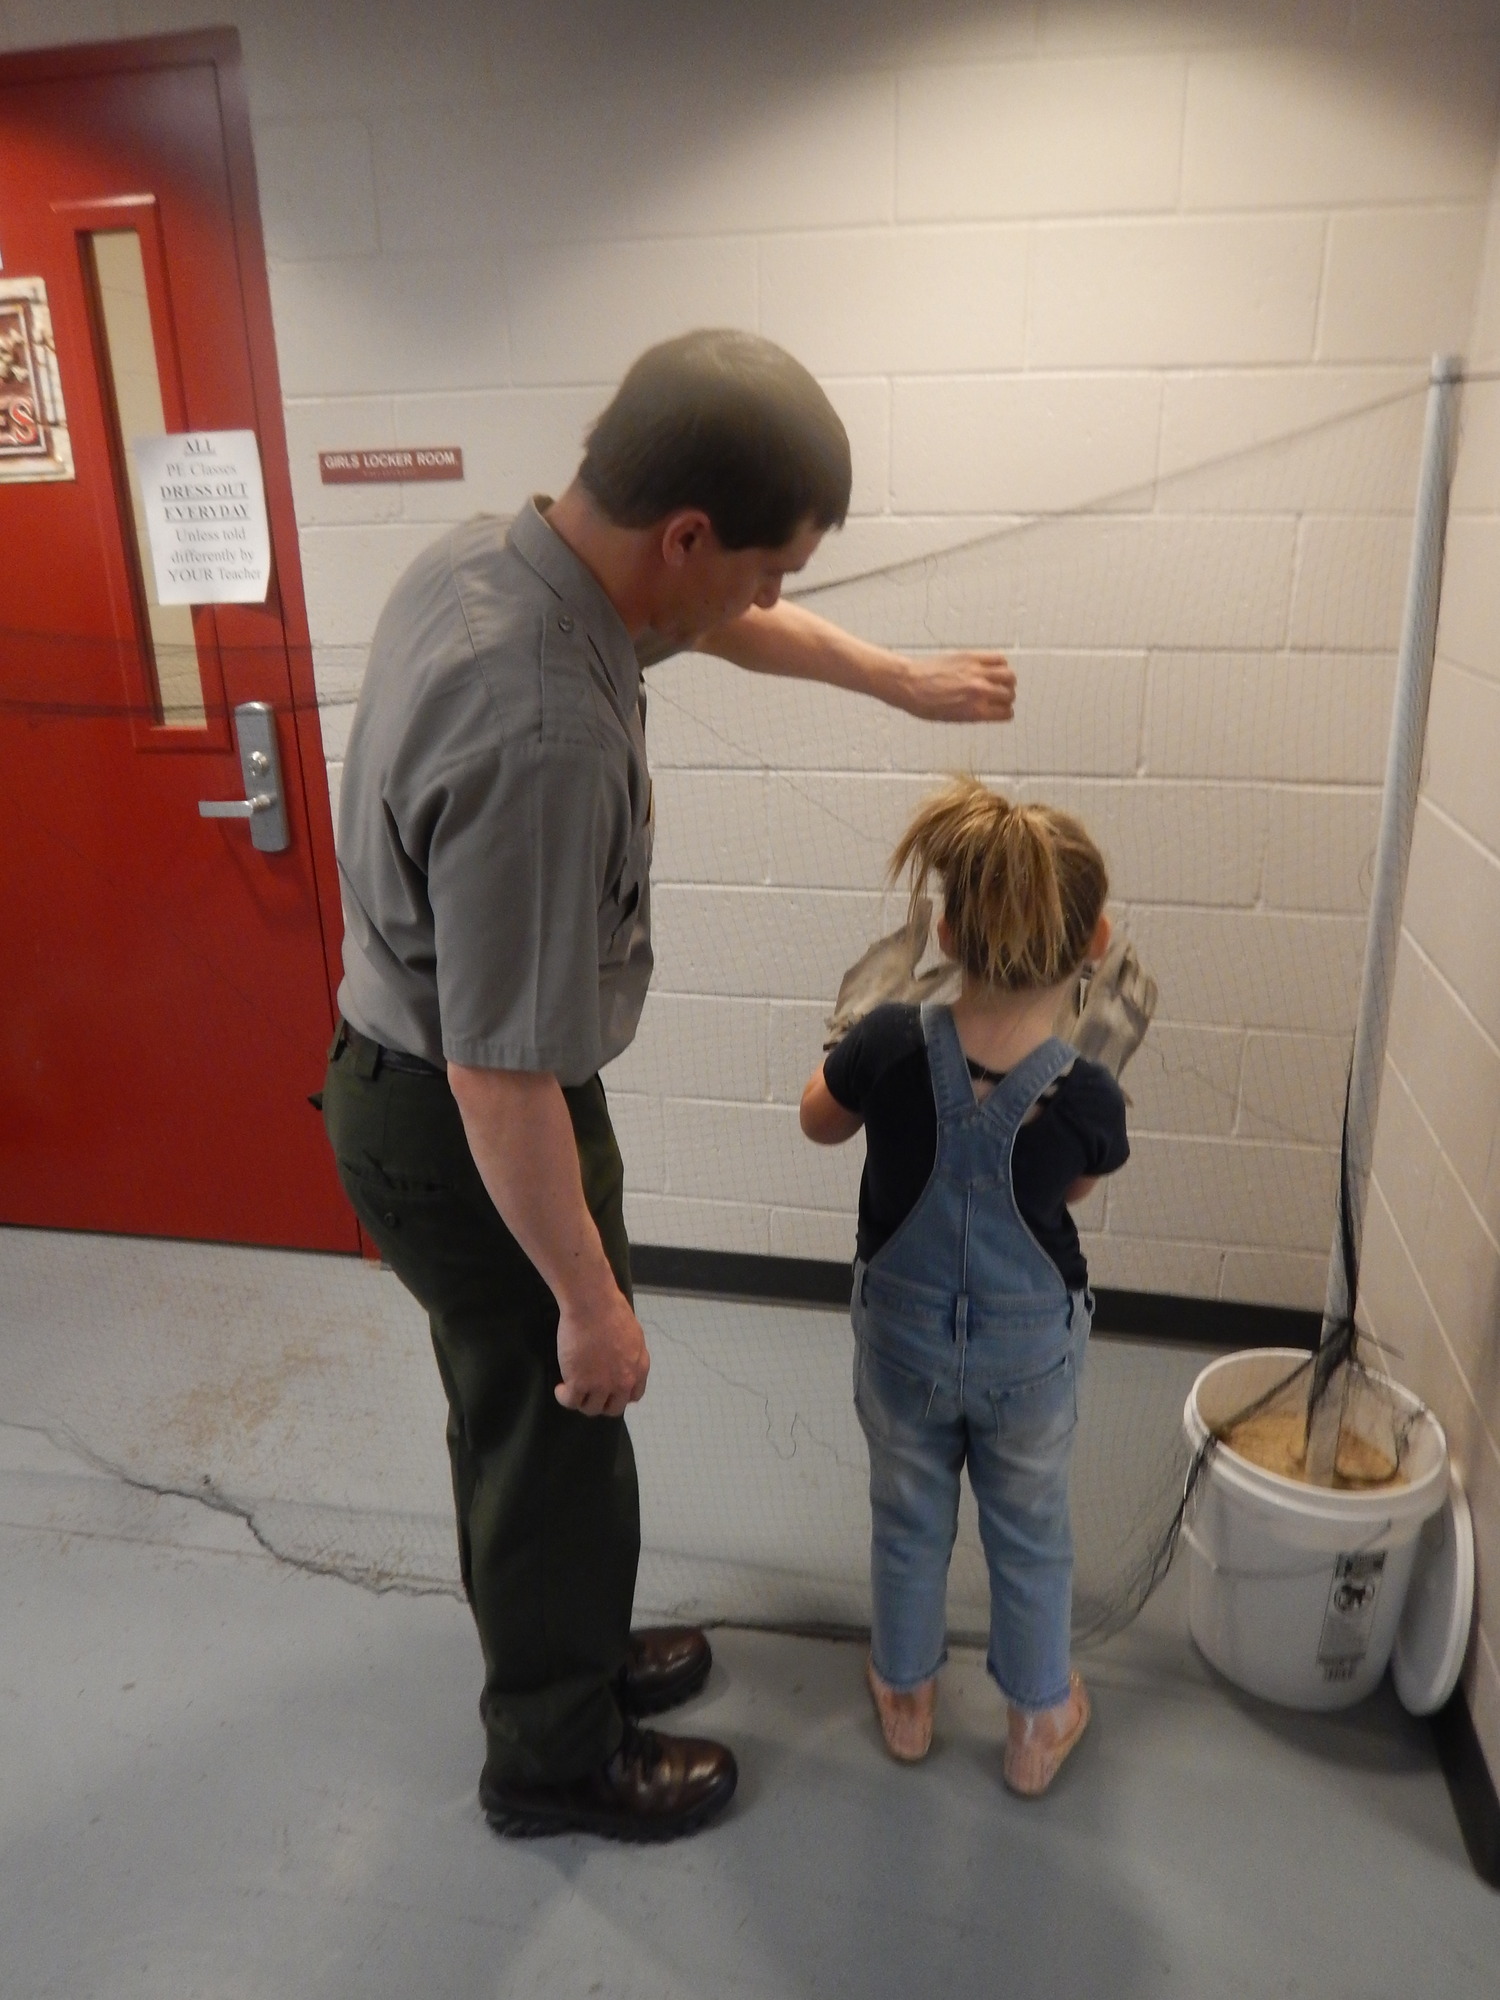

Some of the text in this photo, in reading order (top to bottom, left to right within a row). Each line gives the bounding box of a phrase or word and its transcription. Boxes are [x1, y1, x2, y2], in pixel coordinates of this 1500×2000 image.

[184, 439, 216, 454] ALL
[325, 450, 456, 469] GIRLS LOCKER ROOM
[167, 462, 237, 477] PE Classes
[160, 483, 248, 500] DRESS OUT
[164, 504, 250, 520] EVERYDAY
[176, 526, 246, 543] Unless told
[171, 548, 254, 565] differently by
[168, 567, 262, 582] YOUR Teacher
